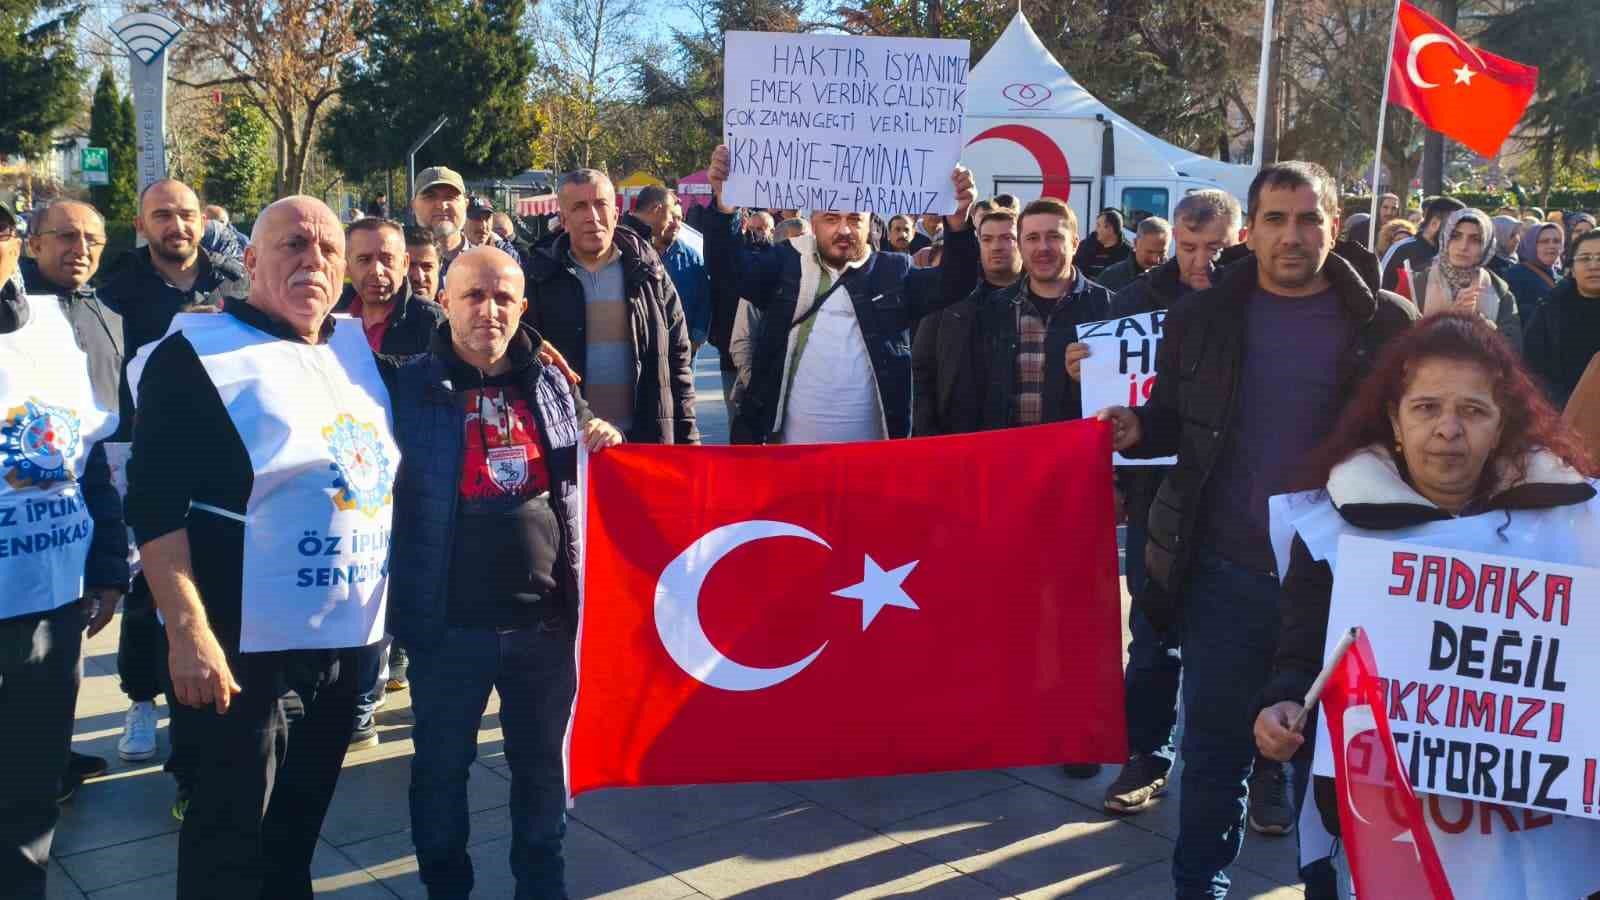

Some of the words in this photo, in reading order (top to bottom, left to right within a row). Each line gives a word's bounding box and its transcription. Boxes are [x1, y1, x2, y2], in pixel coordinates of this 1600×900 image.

[773, 45, 869, 78] HAKTIR
[885, 49, 969, 85] İSYANIMIZ
[750, 79, 802, 104] EMEK
[812, 79, 879, 107] VERDİK
[726, 108, 756, 128] ÇOK
[760, 109, 811, 129] ZAMAN
[870, 112, 962, 136] VERİLMEDİ
[0, 507, 17, 527] Z
[0, 524, 89, 558] ENDİKAS
[298, 531, 342, 556] ÖZ
[1388, 551, 1573, 626] SADAKA
[1428, 620, 1566, 692] DEĞİL
